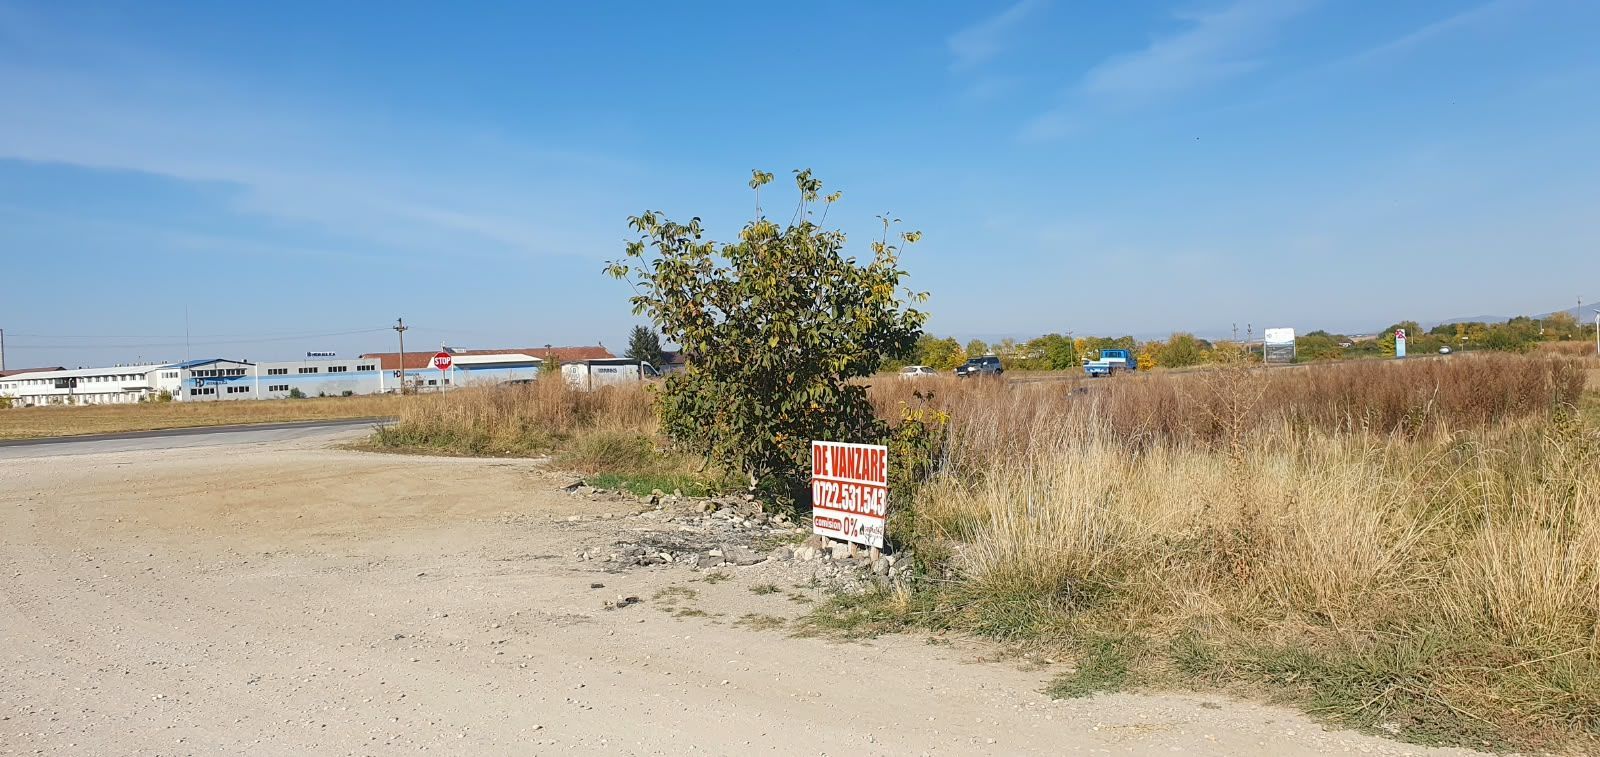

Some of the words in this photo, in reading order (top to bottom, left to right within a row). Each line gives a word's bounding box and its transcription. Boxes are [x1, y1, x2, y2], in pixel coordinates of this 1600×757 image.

[434, 356, 451, 365] STOP
[814, 444, 828, 476] DE
[831, 445, 886, 483] VANZARE
[813, 480, 886, 516] 0722.531.543
[815, 517, 841, 531] comision
[844, 516, 858, 537] 0%
